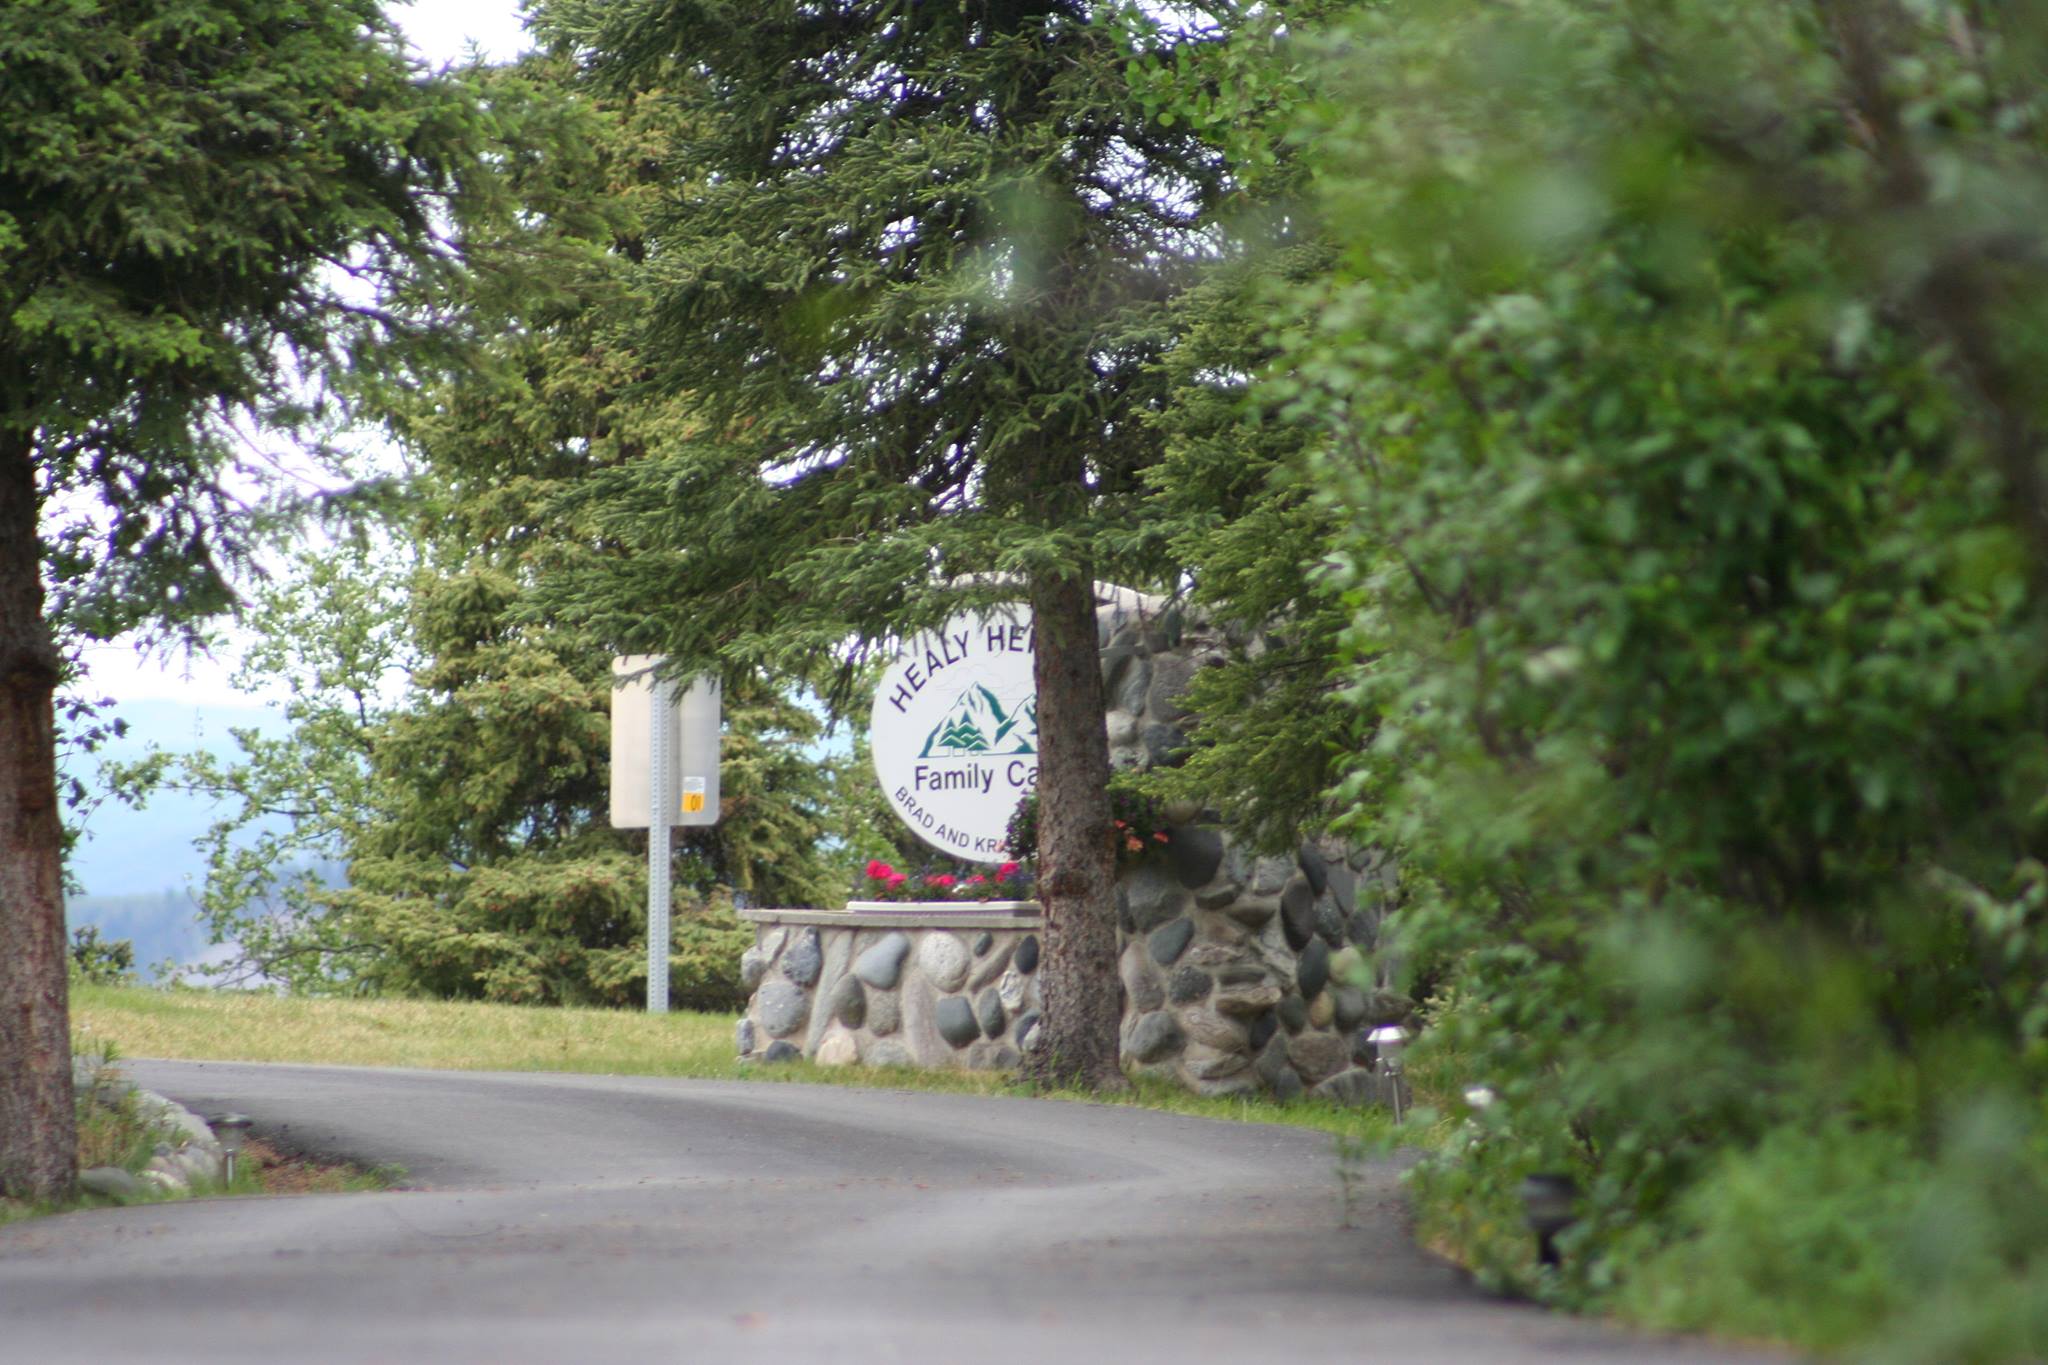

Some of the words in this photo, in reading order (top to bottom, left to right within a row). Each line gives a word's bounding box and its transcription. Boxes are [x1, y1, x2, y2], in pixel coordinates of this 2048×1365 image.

[889, 629, 969, 713] HEALY
[914, 763, 994, 794] Family
[895, 786, 935, 829] BRAD
[935, 824, 970, 849] AND
[974, 836, 1003, 853] KR
